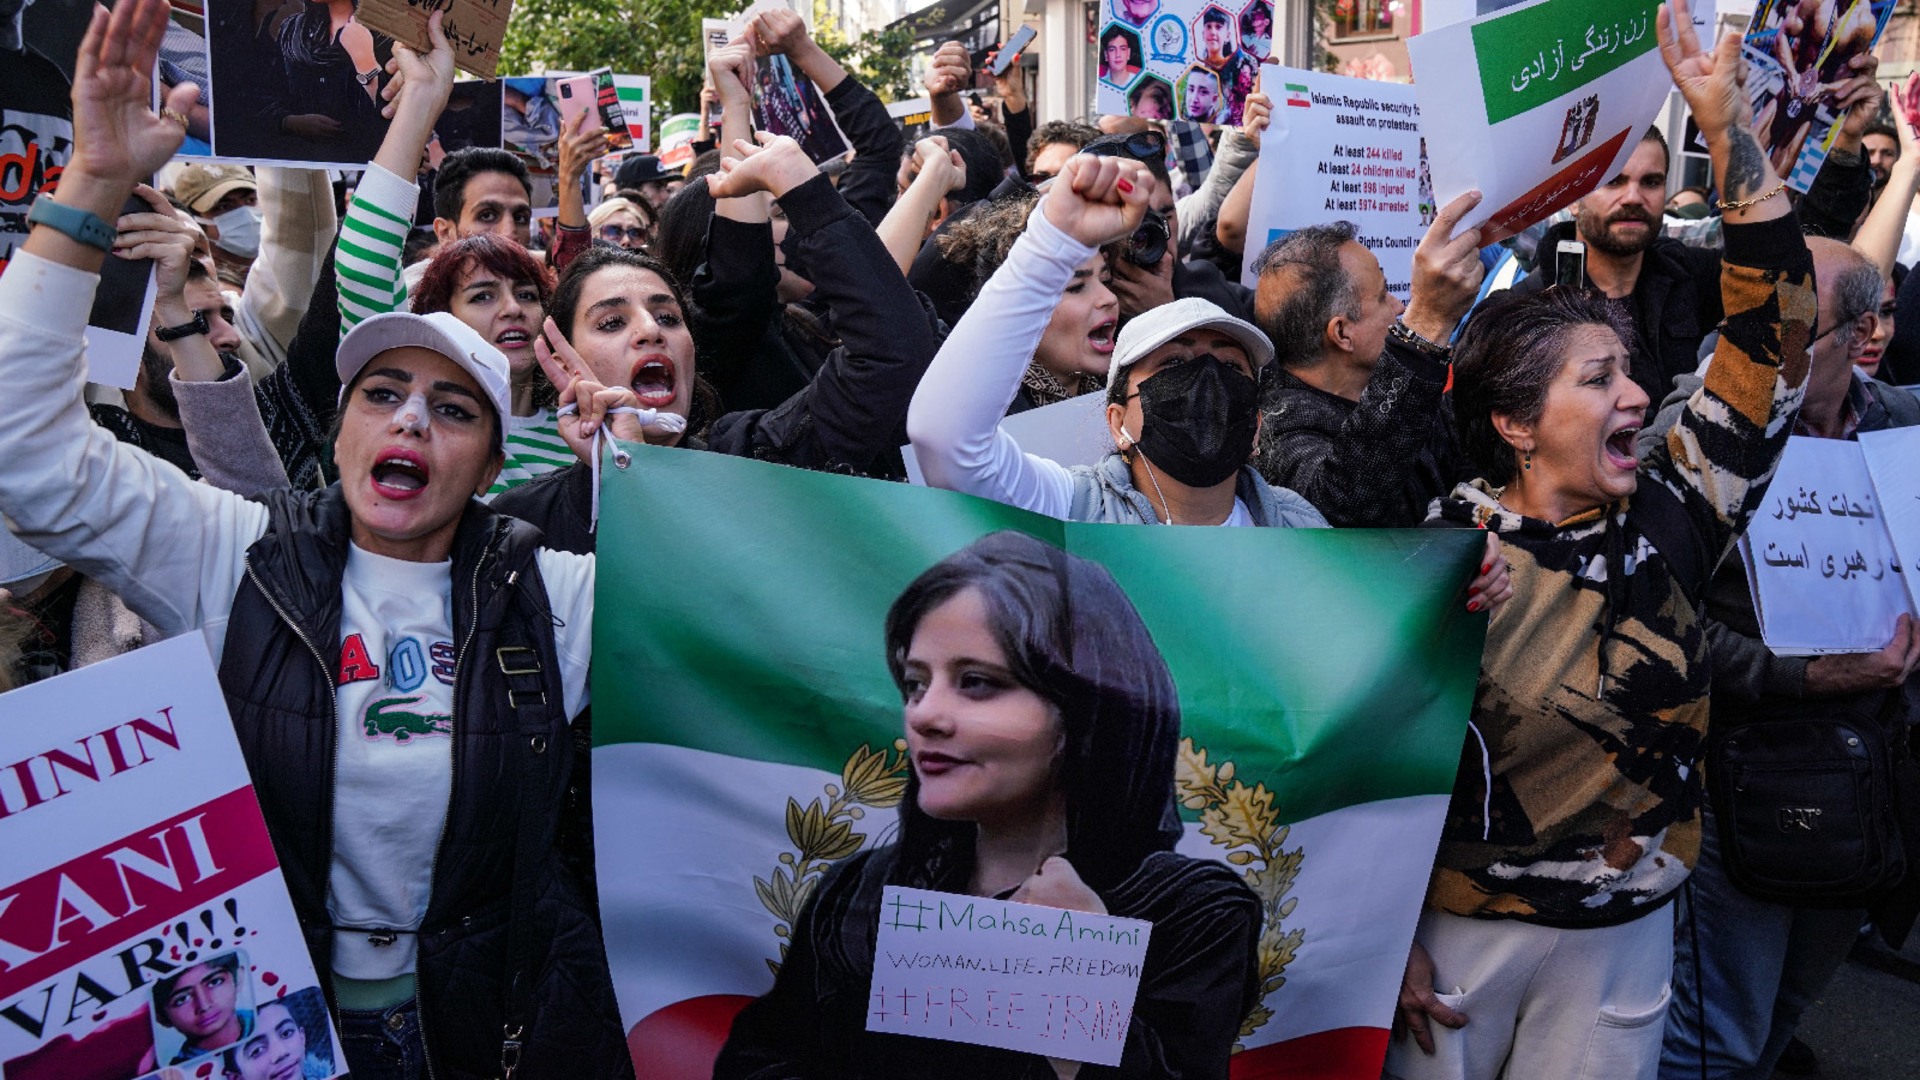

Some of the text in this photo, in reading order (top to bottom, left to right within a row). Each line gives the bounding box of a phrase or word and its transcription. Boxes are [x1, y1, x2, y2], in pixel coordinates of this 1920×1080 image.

[1570, 23, 1620, 72] زندگی
[1511, 39, 1564, 92] آزادی
[1311, 92, 1342, 106] Islamic
[1343, 96, 1379, 111] Republic
[1381, 102, 1411, 117] security
[1336, 114, 1419, 132] assault on protesters:
[1334, 144, 1403, 161] At least 244 killed
[1317, 161, 1416, 179] At least 24 children killed
[1330, 180, 1340, 192] At
[1342, 180, 1362, 193] least
[1379, 182, 1405, 197] injured
[1325, 198, 1335, 210] At
[1336, 198, 1357, 211] least
[1379, 200, 1409, 213] arrested
[1385, 236, 1412, 248] Council
[1771, 486, 1875, 525] نجات کشور
[1763, 541, 1810, 570] است
